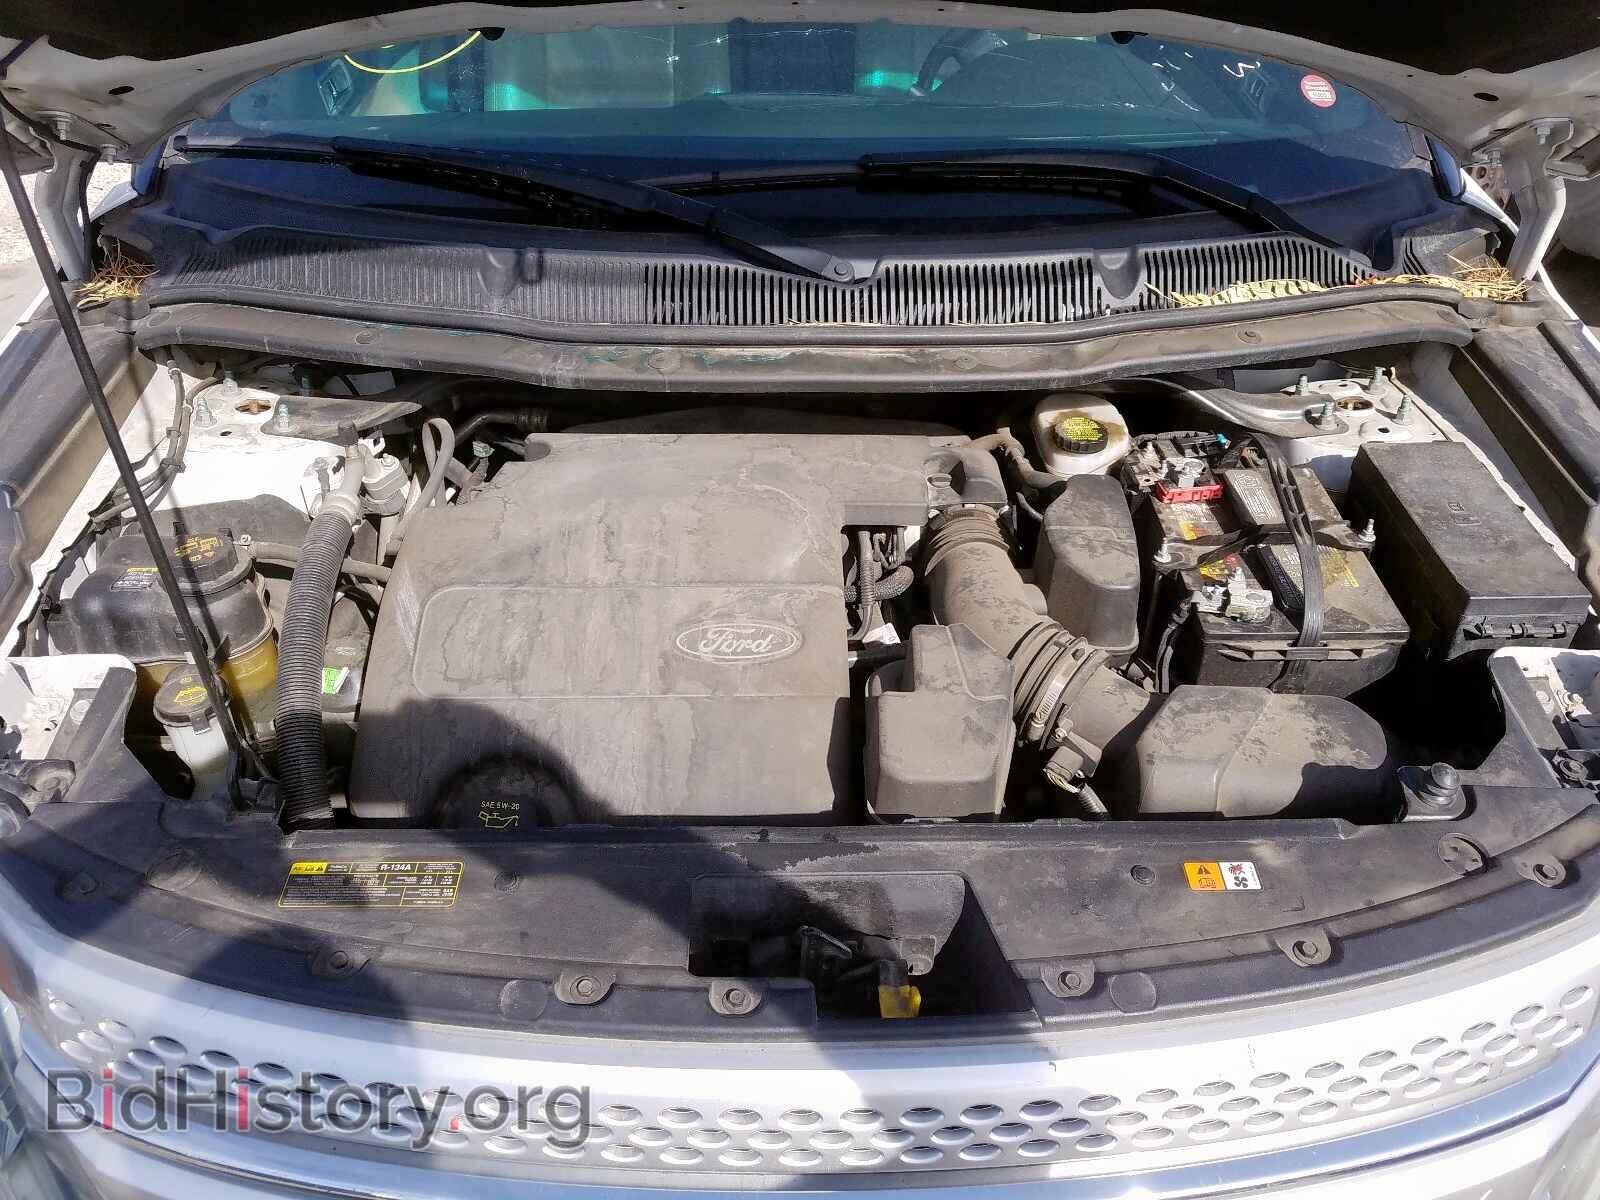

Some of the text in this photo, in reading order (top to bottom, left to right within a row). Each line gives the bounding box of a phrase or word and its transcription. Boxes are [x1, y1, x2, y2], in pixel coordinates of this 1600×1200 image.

[700, 627, 774, 653] Ford
[481, 800, 520, 810] SAE 5W-20
[380, 863, 412, 871] R-134A
